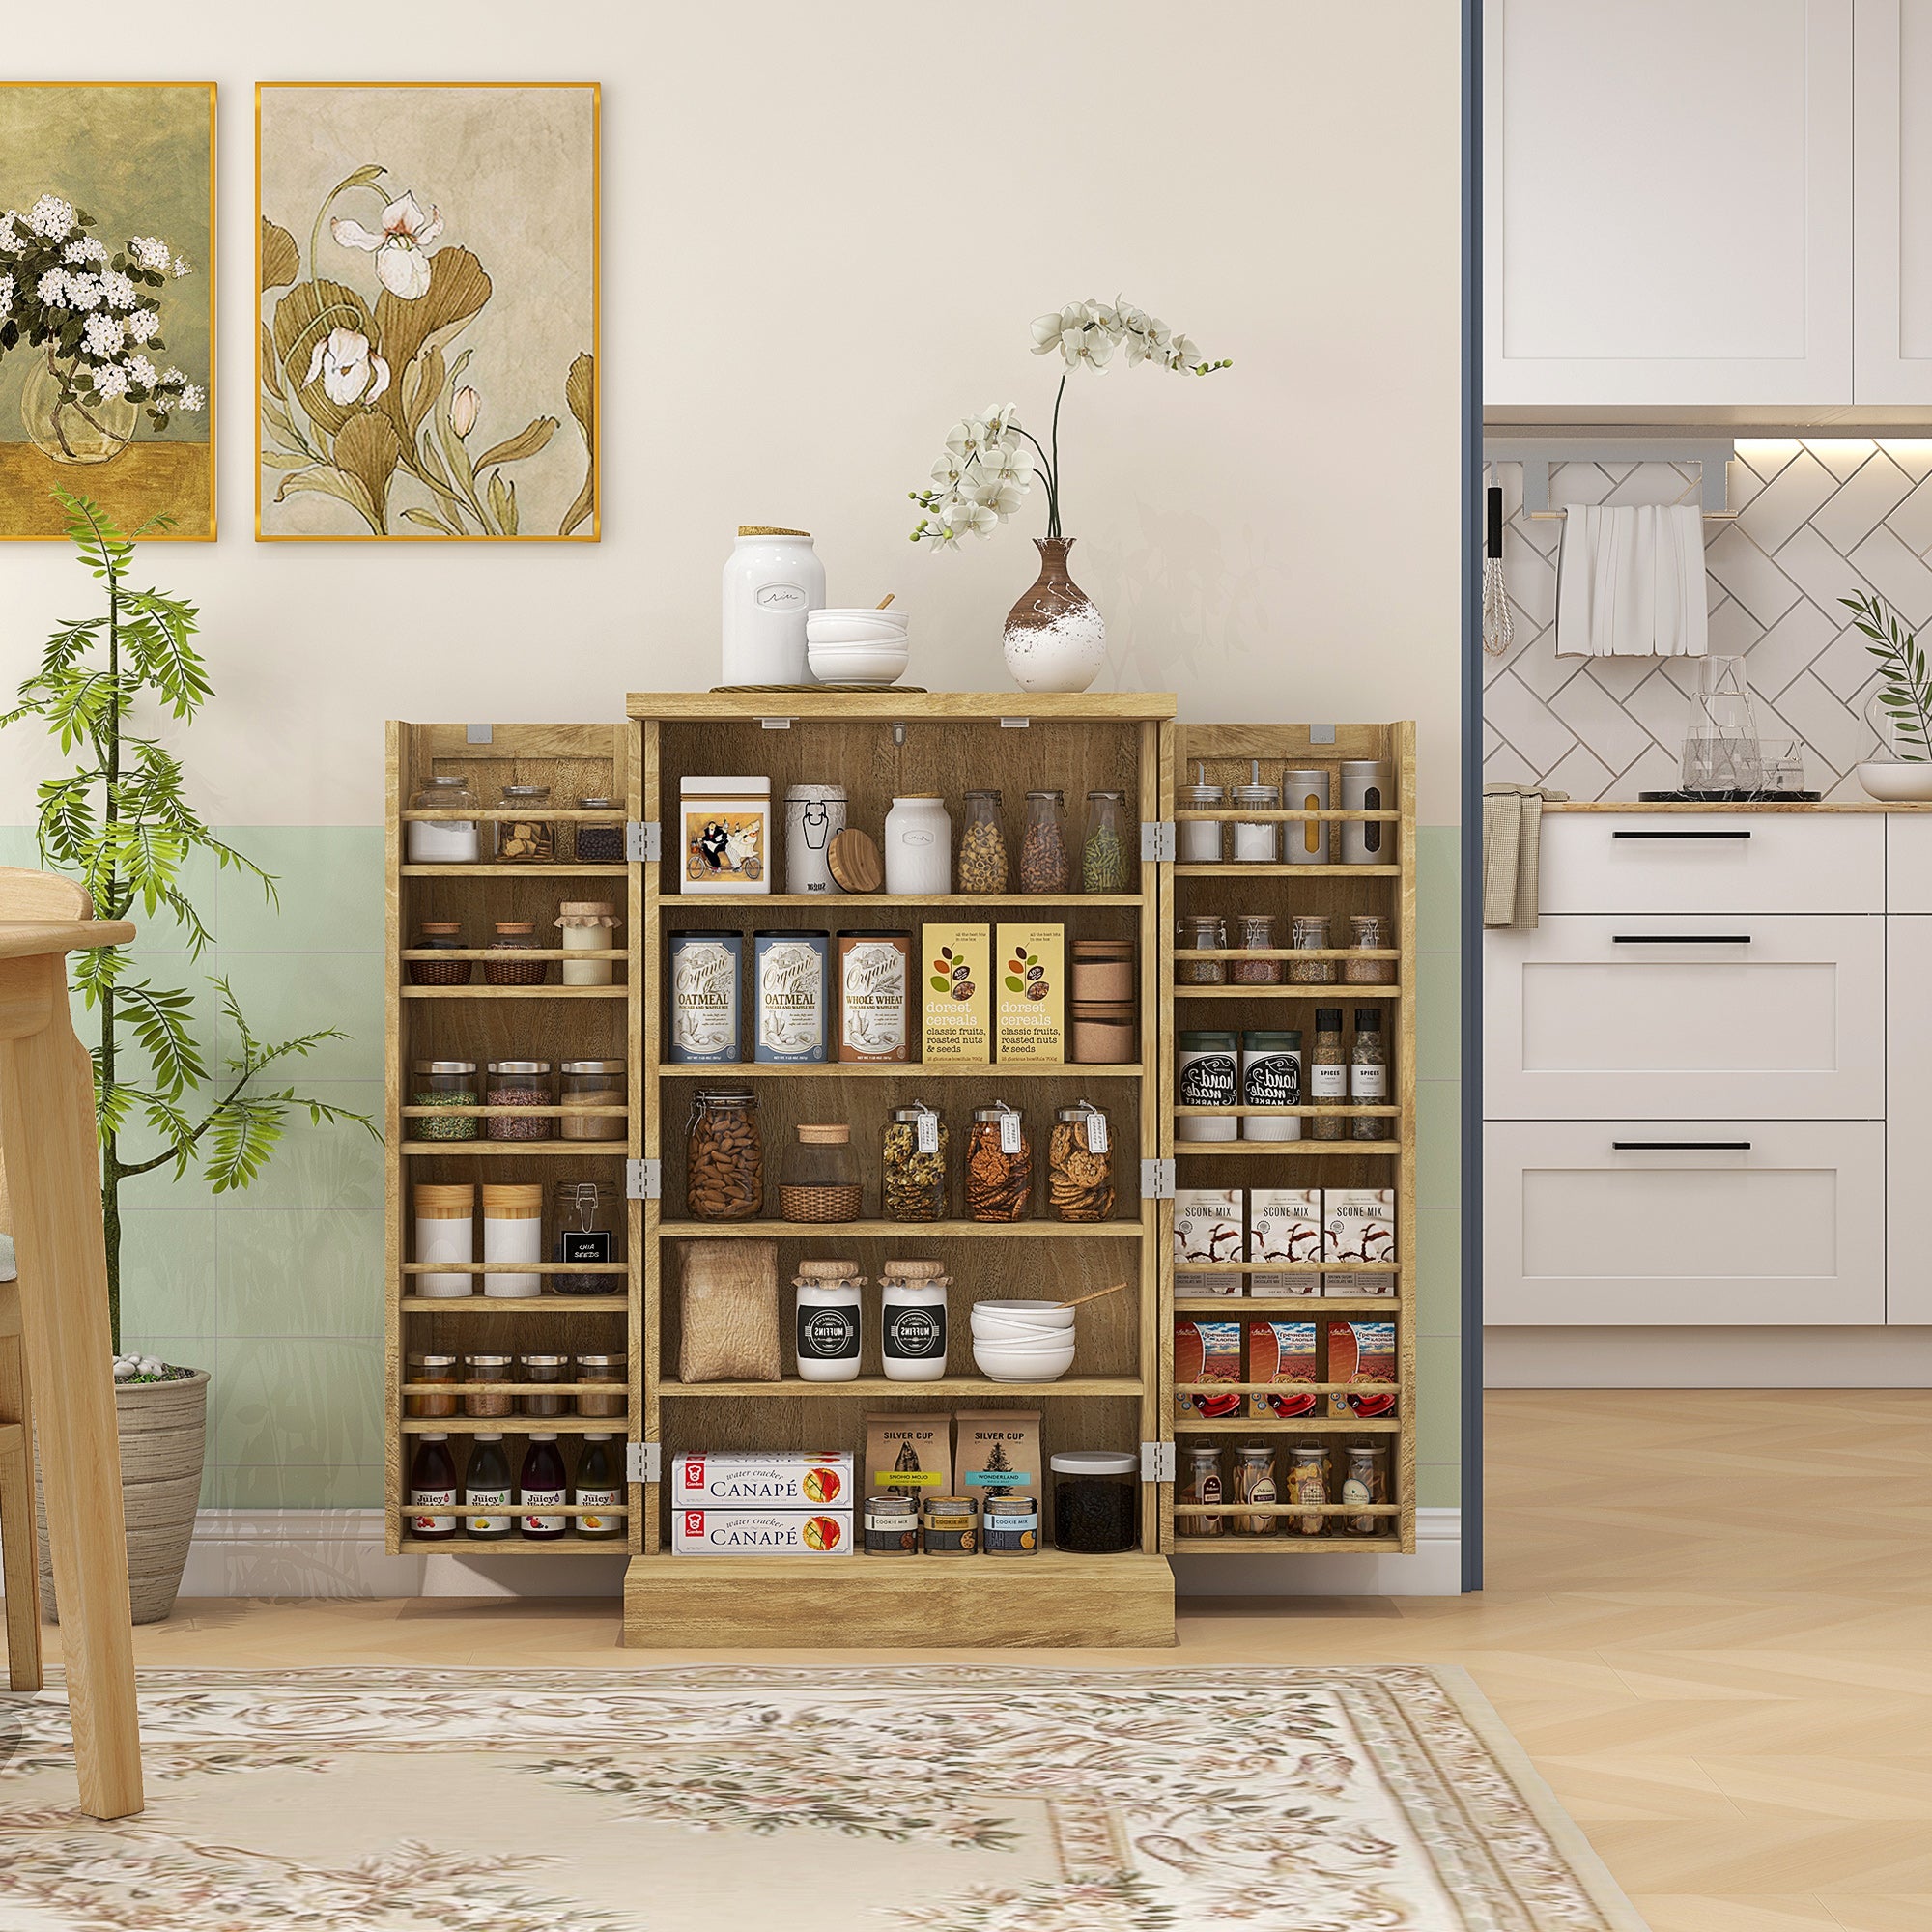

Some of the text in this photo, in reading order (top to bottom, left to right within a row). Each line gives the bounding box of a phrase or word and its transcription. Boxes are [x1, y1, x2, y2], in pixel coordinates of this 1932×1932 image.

[676, 955, 727, 992] Organic
[763, 955, 814, 992] Organic
[846, 955, 898, 991] Organic
[678, 994, 729, 1005] OATMEAL
[765, 994, 816, 1005] OATMEAL
[846, 995, 903, 1004] WHOLE WHEAT
[926, 1001, 972, 1013] dorset
[1001, 1001, 1046, 1013] dorset
[926, 1014, 978, 1026] cereals
[1001, 1014, 1052, 1026] cereals
[959, 1027, 986, 1036] fruits,
[1033, 1027, 1060, 1036] fruits,
[1185, 1207, 1231, 1217] SCONE MIX
[1263, 1207, 1309, 1217] SCONE MIX
[1336, 1207, 1383, 1217] SCONE MIX
[974, 1432, 1004, 1440] SILVER
[726, 1469, 784, 1481] water cracker
[710, 1480, 798, 1497] CANAPÉ
[417, 1495, 444, 1504] Juicy
[473, 1495, 500, 1504] Juicy
[528, 1495, 554, 1504] Juicy
[583, 1495, 610, 1504] Juicy
[726, 1517, 784, 1528] water cracker
[710, 1527, 798, 1545] CANAPÉ
